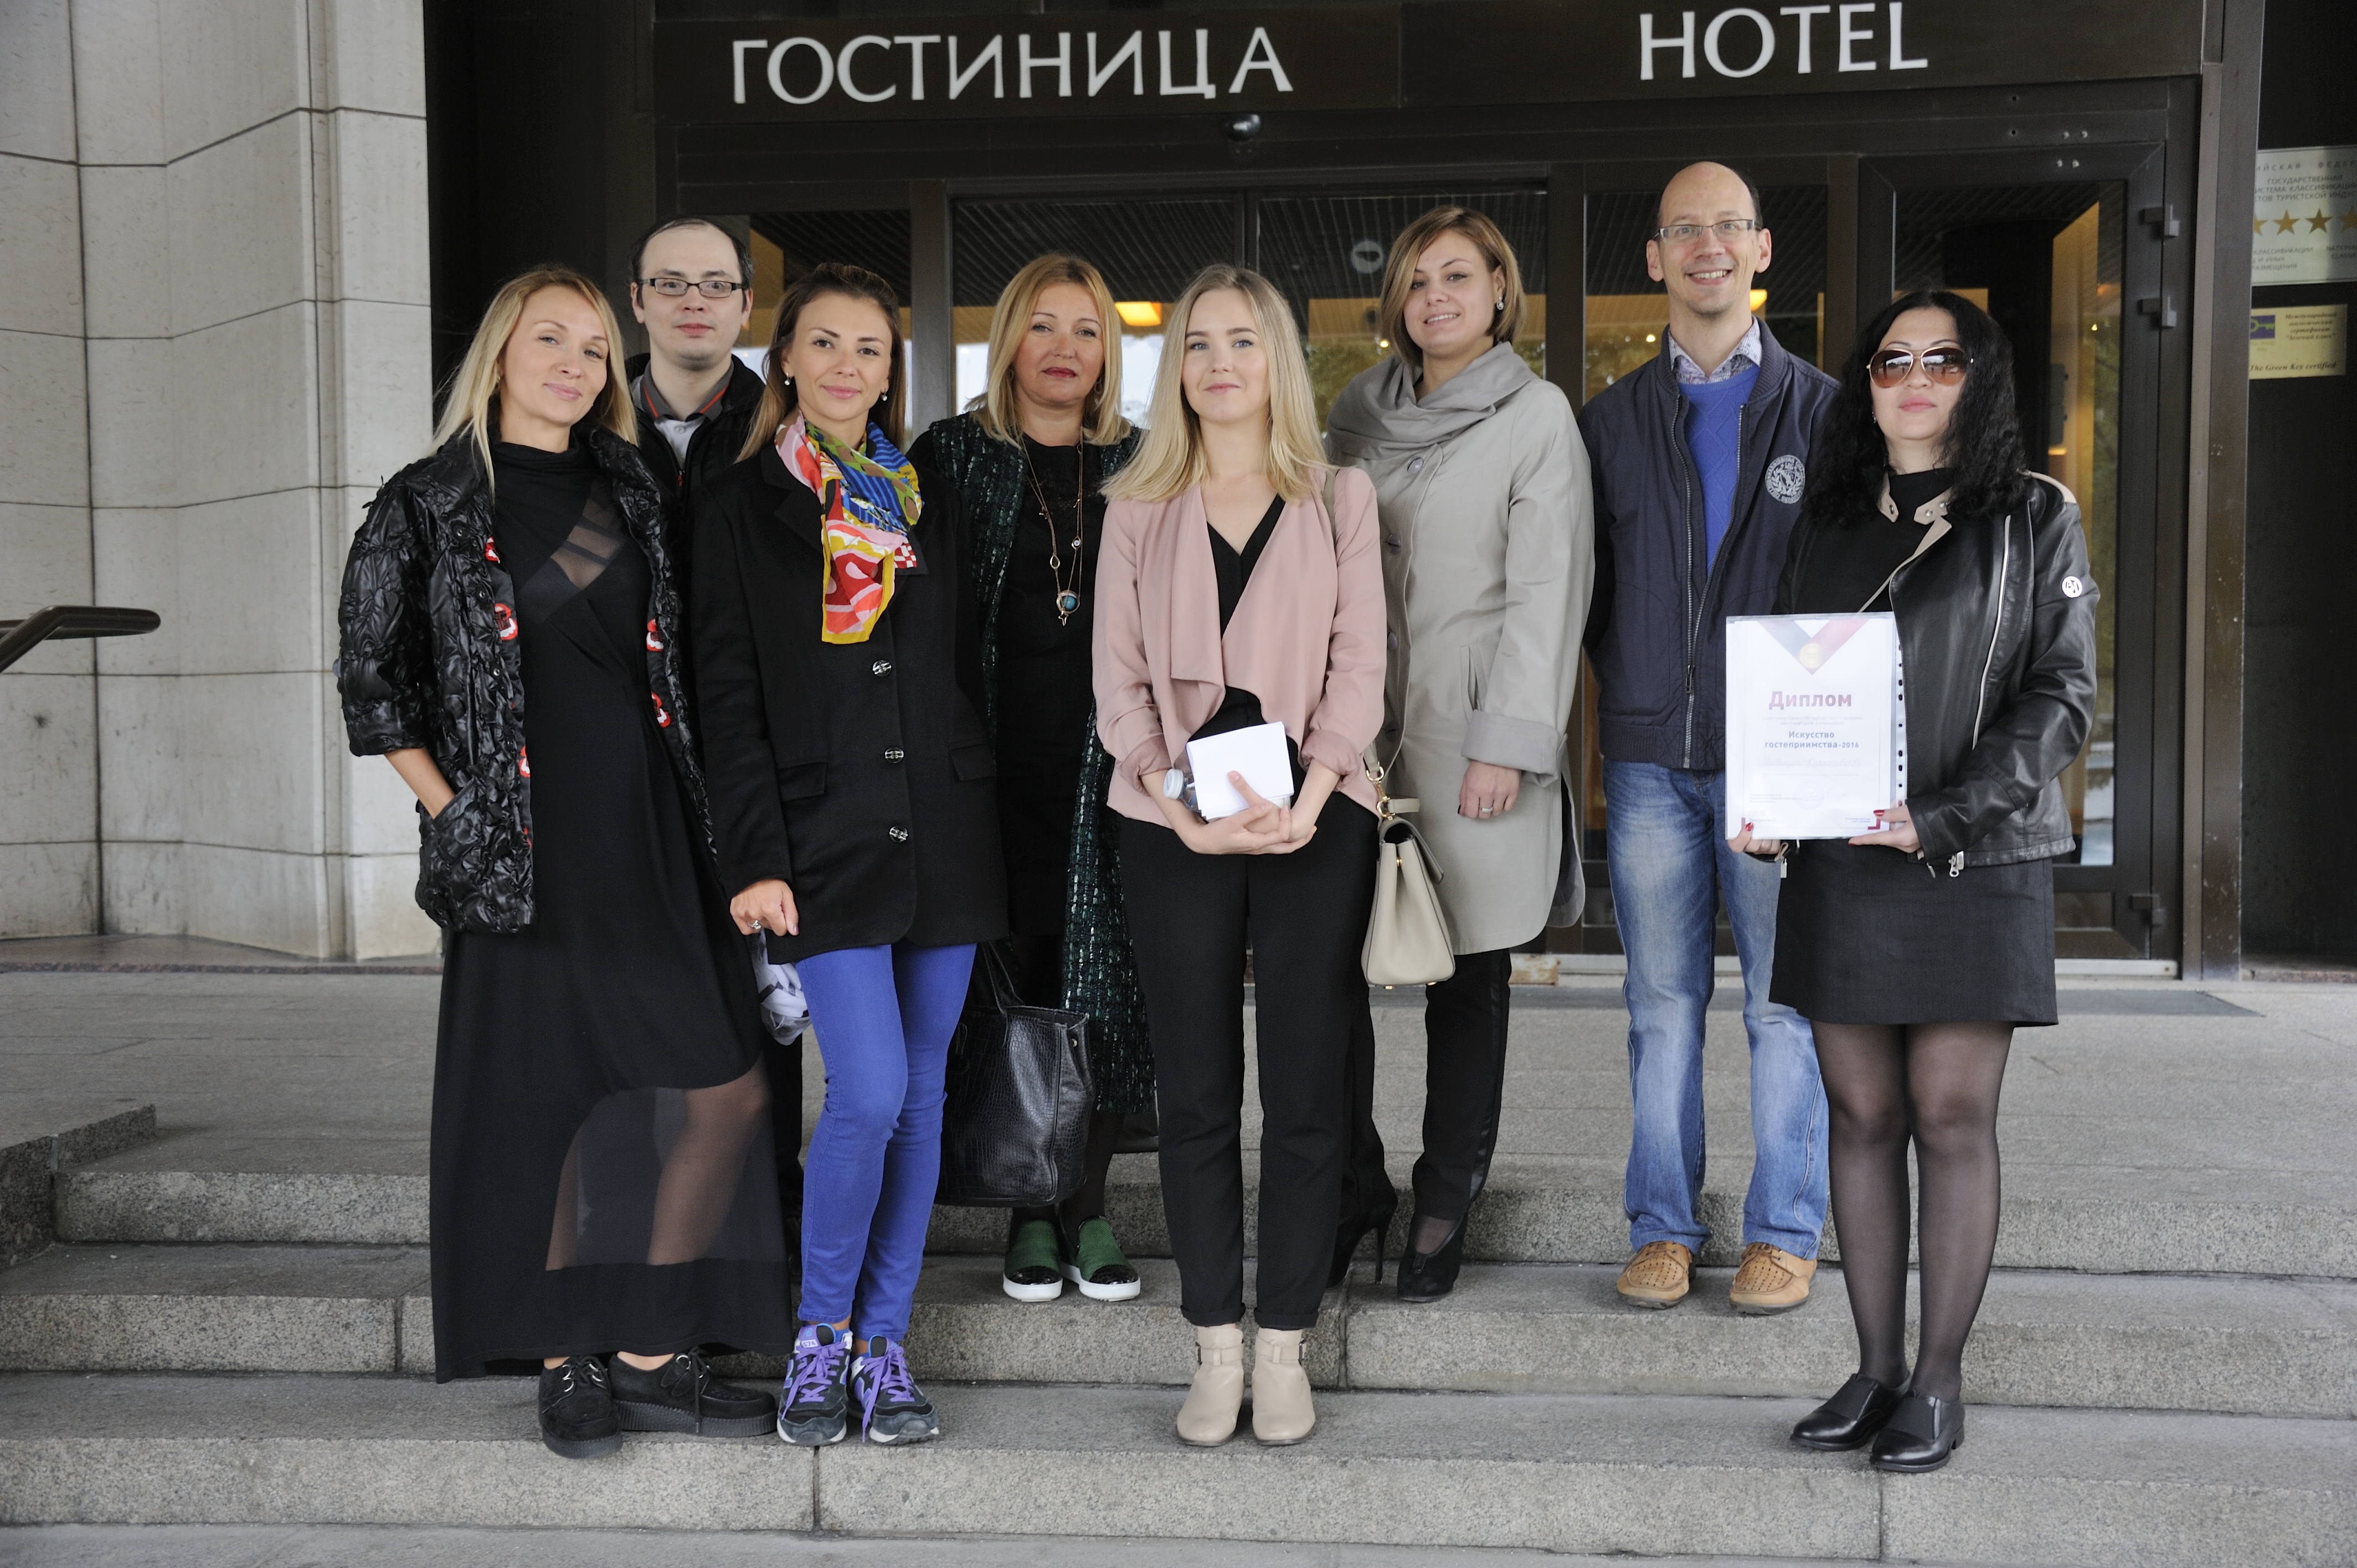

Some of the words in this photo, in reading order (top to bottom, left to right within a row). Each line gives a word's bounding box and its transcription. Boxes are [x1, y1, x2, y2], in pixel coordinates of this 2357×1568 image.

[1640, 2, 1928, 80] HOTEL
[732, 27, 1293, 105] ГОСТИНИЦА
[2267, 174, 2343, 185] ГОСУДАРСТВЕННАЯ
[2276, 193, 2326, 201] ТУРИСТСКОЙ
[2290, 363, 2304, 371] Key
[2305, 360, 2337, 370] certified
[1768, 691, 1852, 710] Диплом
[1788, 731, 1835, 740] Искусство
[1765, 741, 1860, 750] гостеприимства-2016
